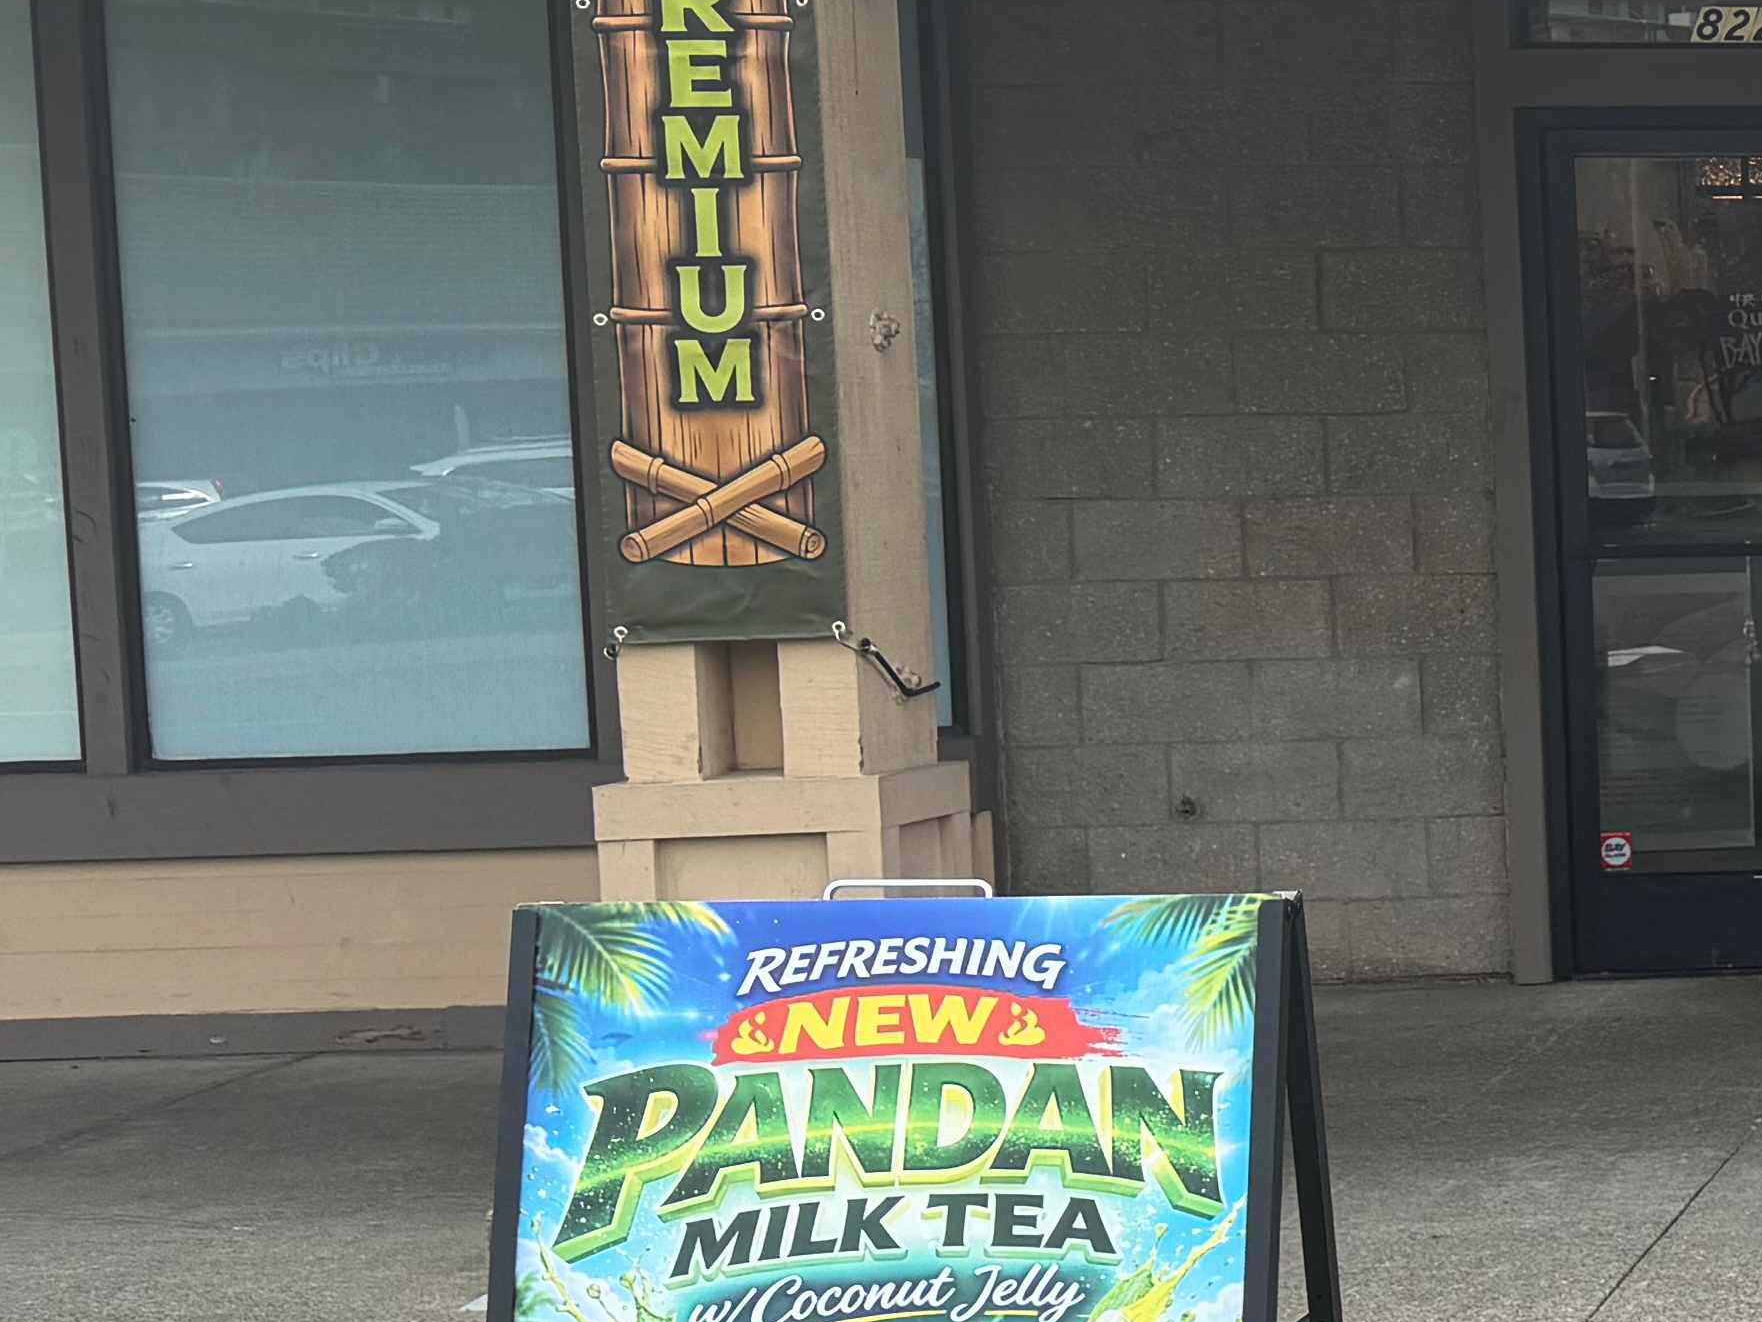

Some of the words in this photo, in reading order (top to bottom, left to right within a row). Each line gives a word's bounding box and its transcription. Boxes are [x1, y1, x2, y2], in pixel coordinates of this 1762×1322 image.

[736, 936, 1067, 997] REFRESHING
[779, 993, 999, 1055] NEW
[553, 1061, 1226, 1263] PANDAN
[672, 1195, 895, 1281] MILK
[922, 1192, 1119, 1256] TEA
